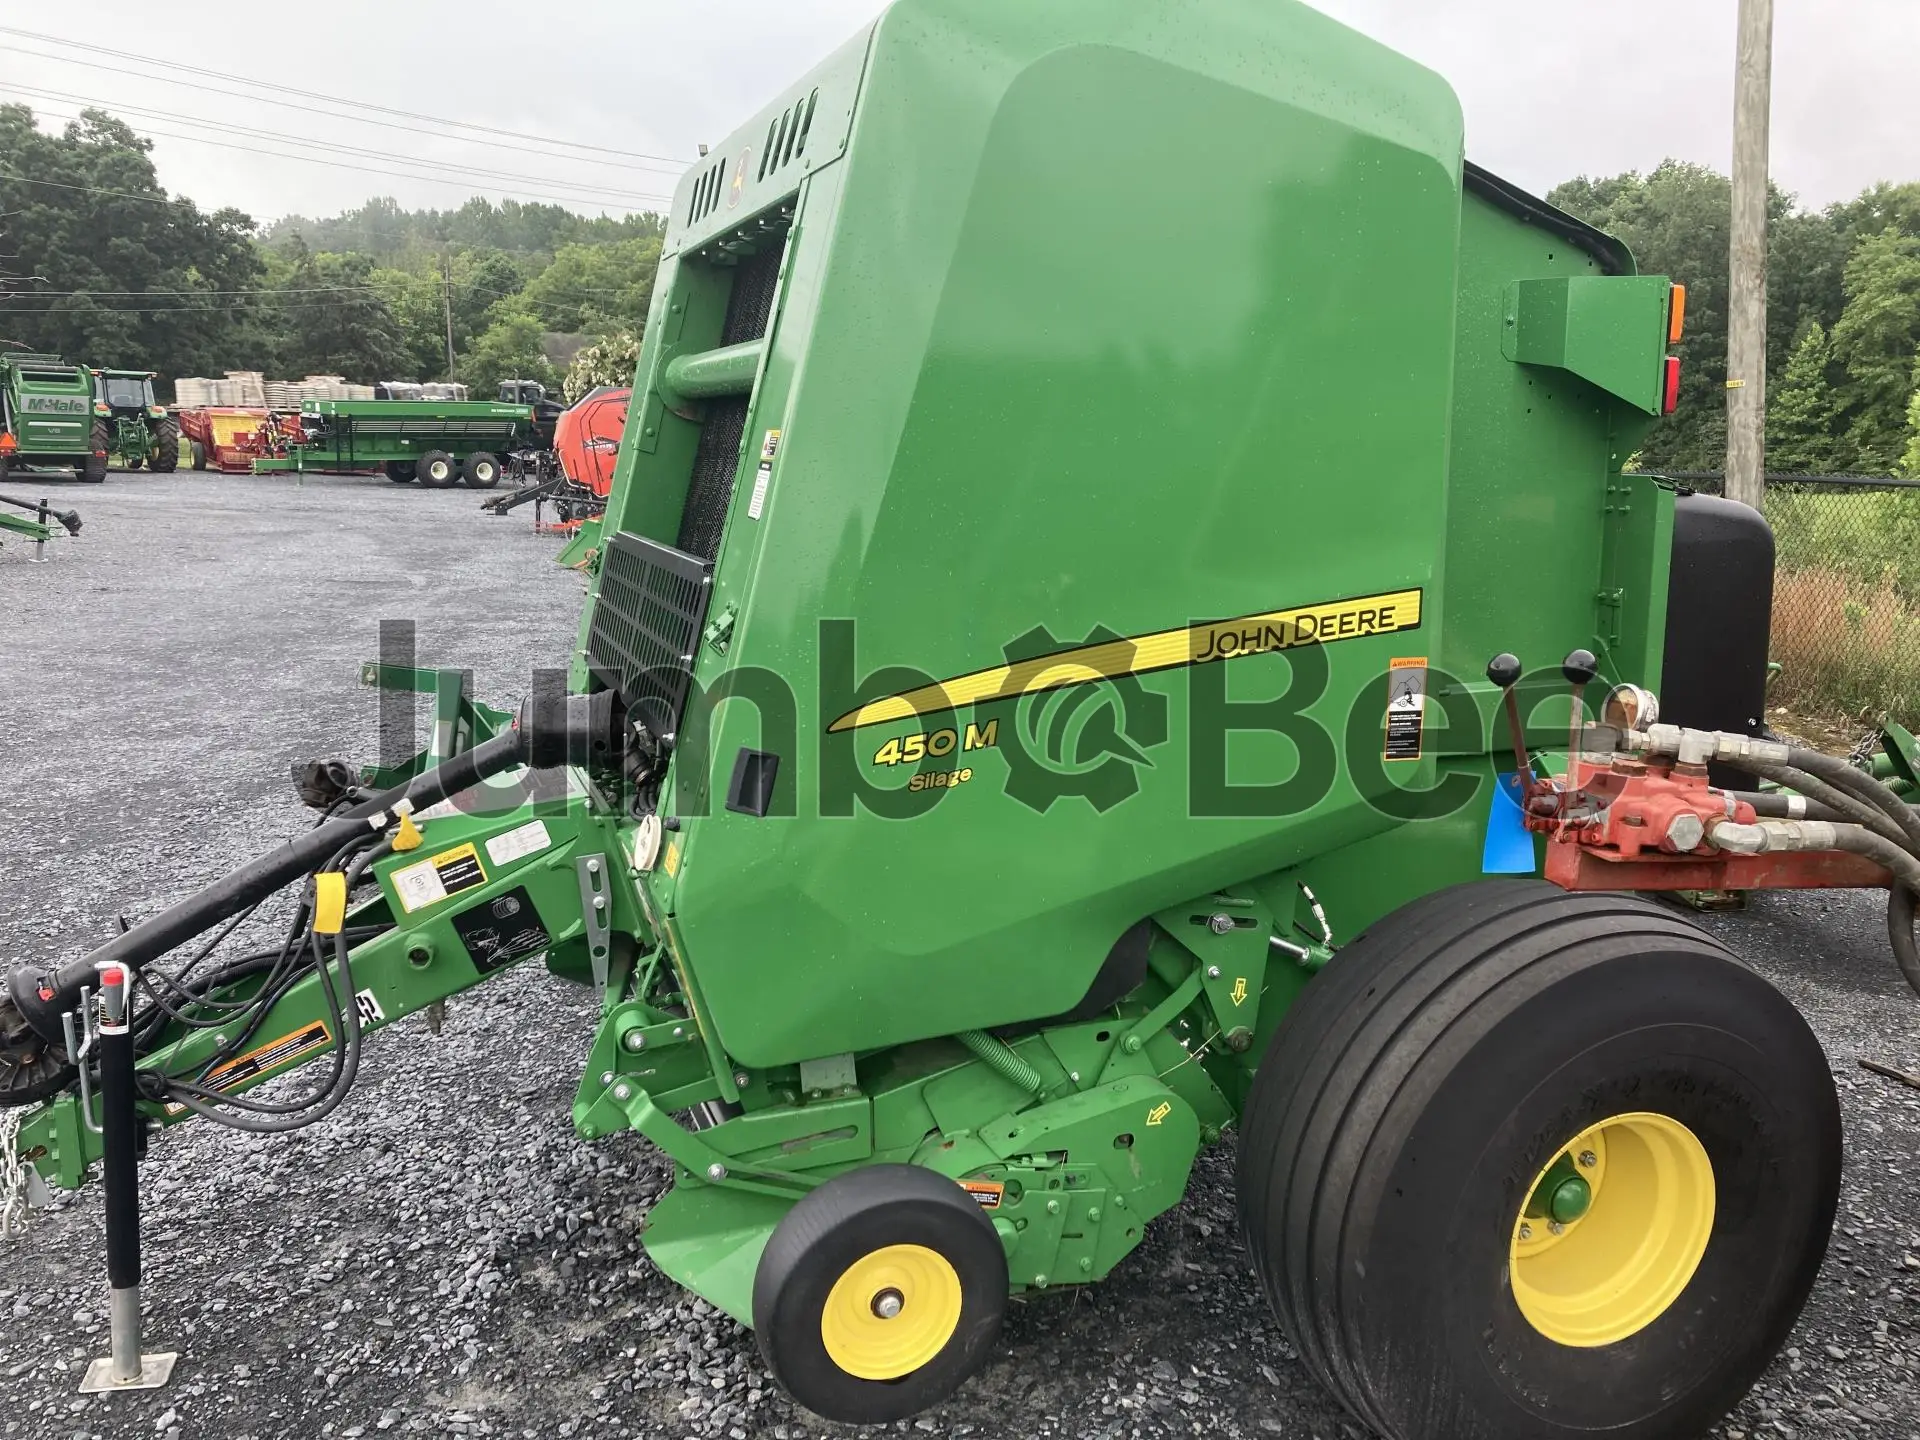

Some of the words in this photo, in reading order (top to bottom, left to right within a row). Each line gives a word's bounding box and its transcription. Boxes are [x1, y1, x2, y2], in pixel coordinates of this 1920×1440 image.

[1196, 622, 1285, 659] JOHN
[1293, 605, 1396, 642] DEERE
[1397, 659, 1425, 667] WARNING
[873, 727, 959, 767] 450
[963, 718, 1000, 752] M
[908, 767, 973, 792] Silage
